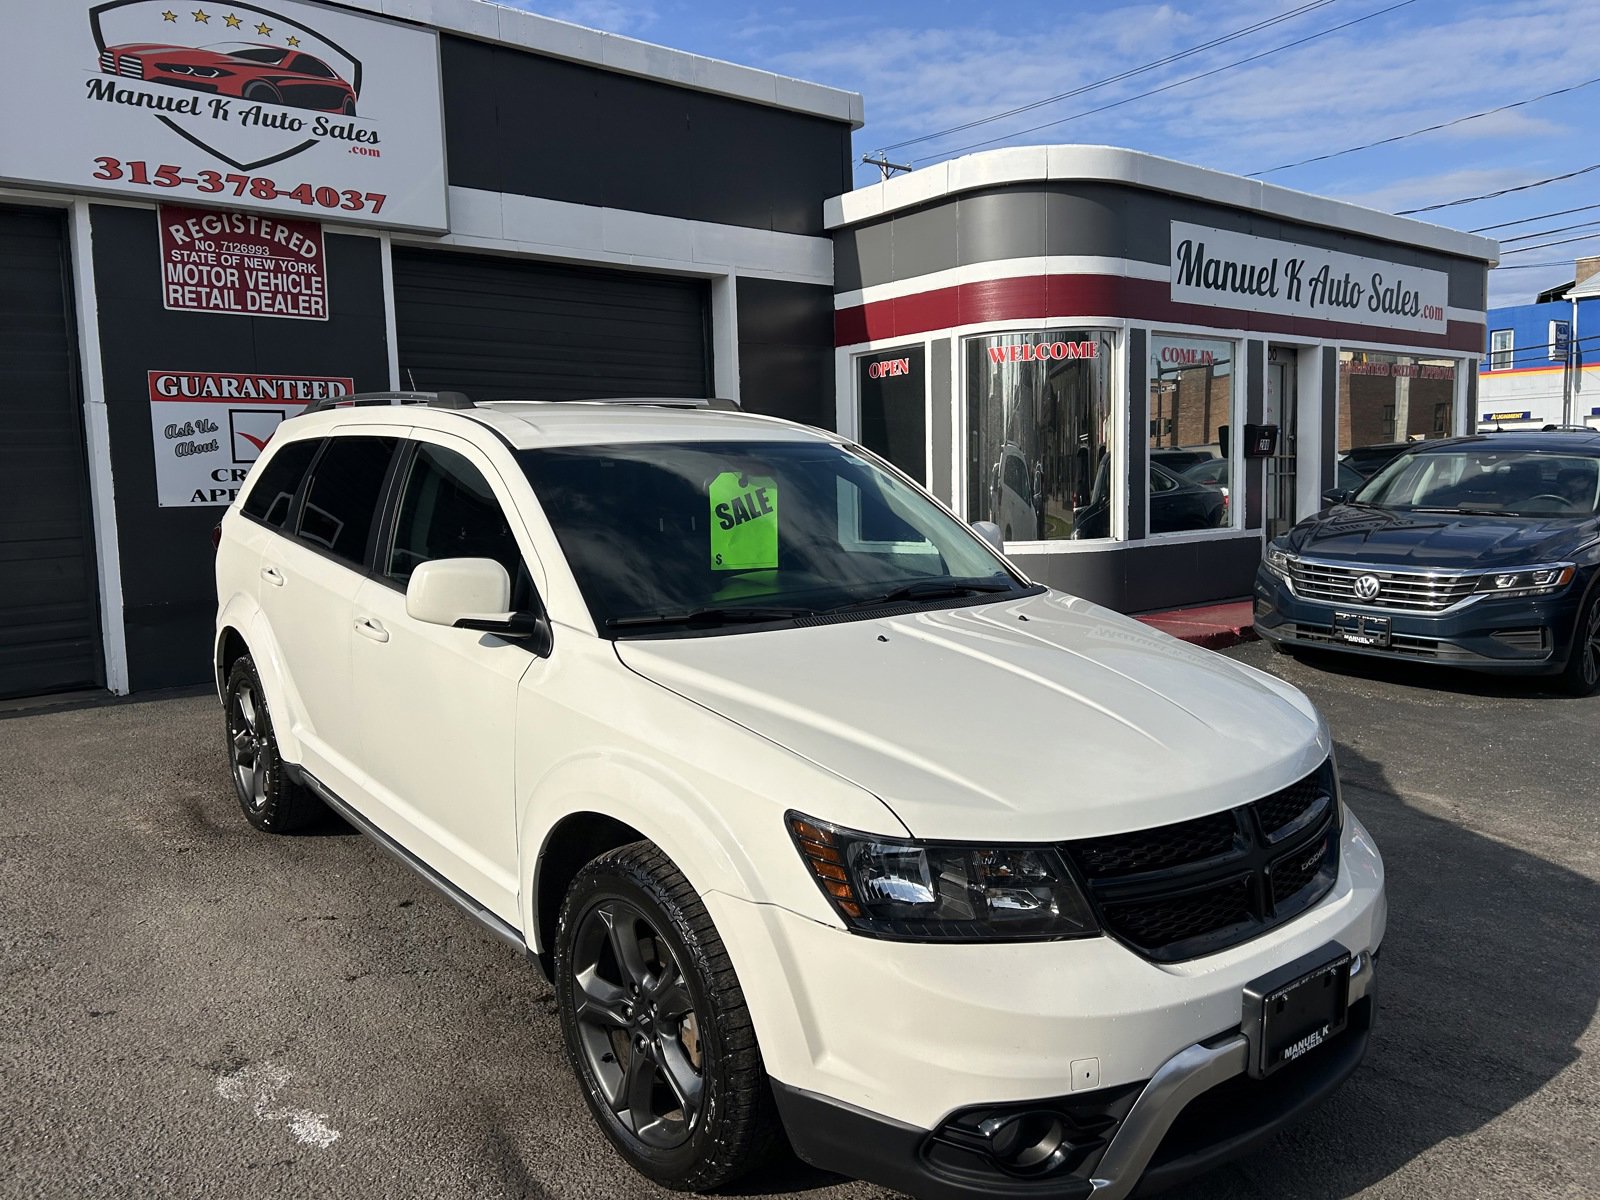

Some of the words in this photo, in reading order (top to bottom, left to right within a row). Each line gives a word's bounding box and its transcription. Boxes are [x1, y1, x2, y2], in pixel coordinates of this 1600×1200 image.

[86, 78, 202, 116] Manuel
[208, 98, 232, 121] K
[239, 104, 307, 131] Auto
[311, 116, 381, 145] Sales
[349, 145, 381, 157] .com
[93, 157, 387, 214] 315-378-4037
[168, 213, 317, 258] REGISTERED
[195, 240, 219, 252] NO.
[221, 241, 270, 256] 7126993
[171, 251, 217, 265] STATE
[221, 254, 240, 266] OF
[244, 257, 275, 271] NEW
[279, 260, 317, 275] YORK
[1176, 239, 1279, 298] Manuel
[1284, 258, 1306, 302] K
[1309, 264, 1365, 308] Auto
[167, 262, 239, 288] MOTOR
[245, 270, 323, 295] VEHICLE
[168, 284, 242, 310] RETAIL
[247, 292, 324, 316] DEALER
[988, 341, 1099, 364] WELCOME
[1161, 346, 1197, 364] COME
[1200, 350, 1213, 365] IN
[869, 357, 910, 379] OPEN
[156, 375, 346, 399] GUARANTEED
[164, 421, 195, 439] Ask
[195, 419, 218, 433] Us
[175, 439, 219, 457] About
[715, 487, 774, 531] SALE
[715, 553, 722, 565] $
[1284, 1031, 1320, 1059] MANUEL
[1322, 1024, 1329, 1036] K
[1291, 1049, 1306, 1060] AUTO
[1306, 1038, 1323, 1051] SALES
